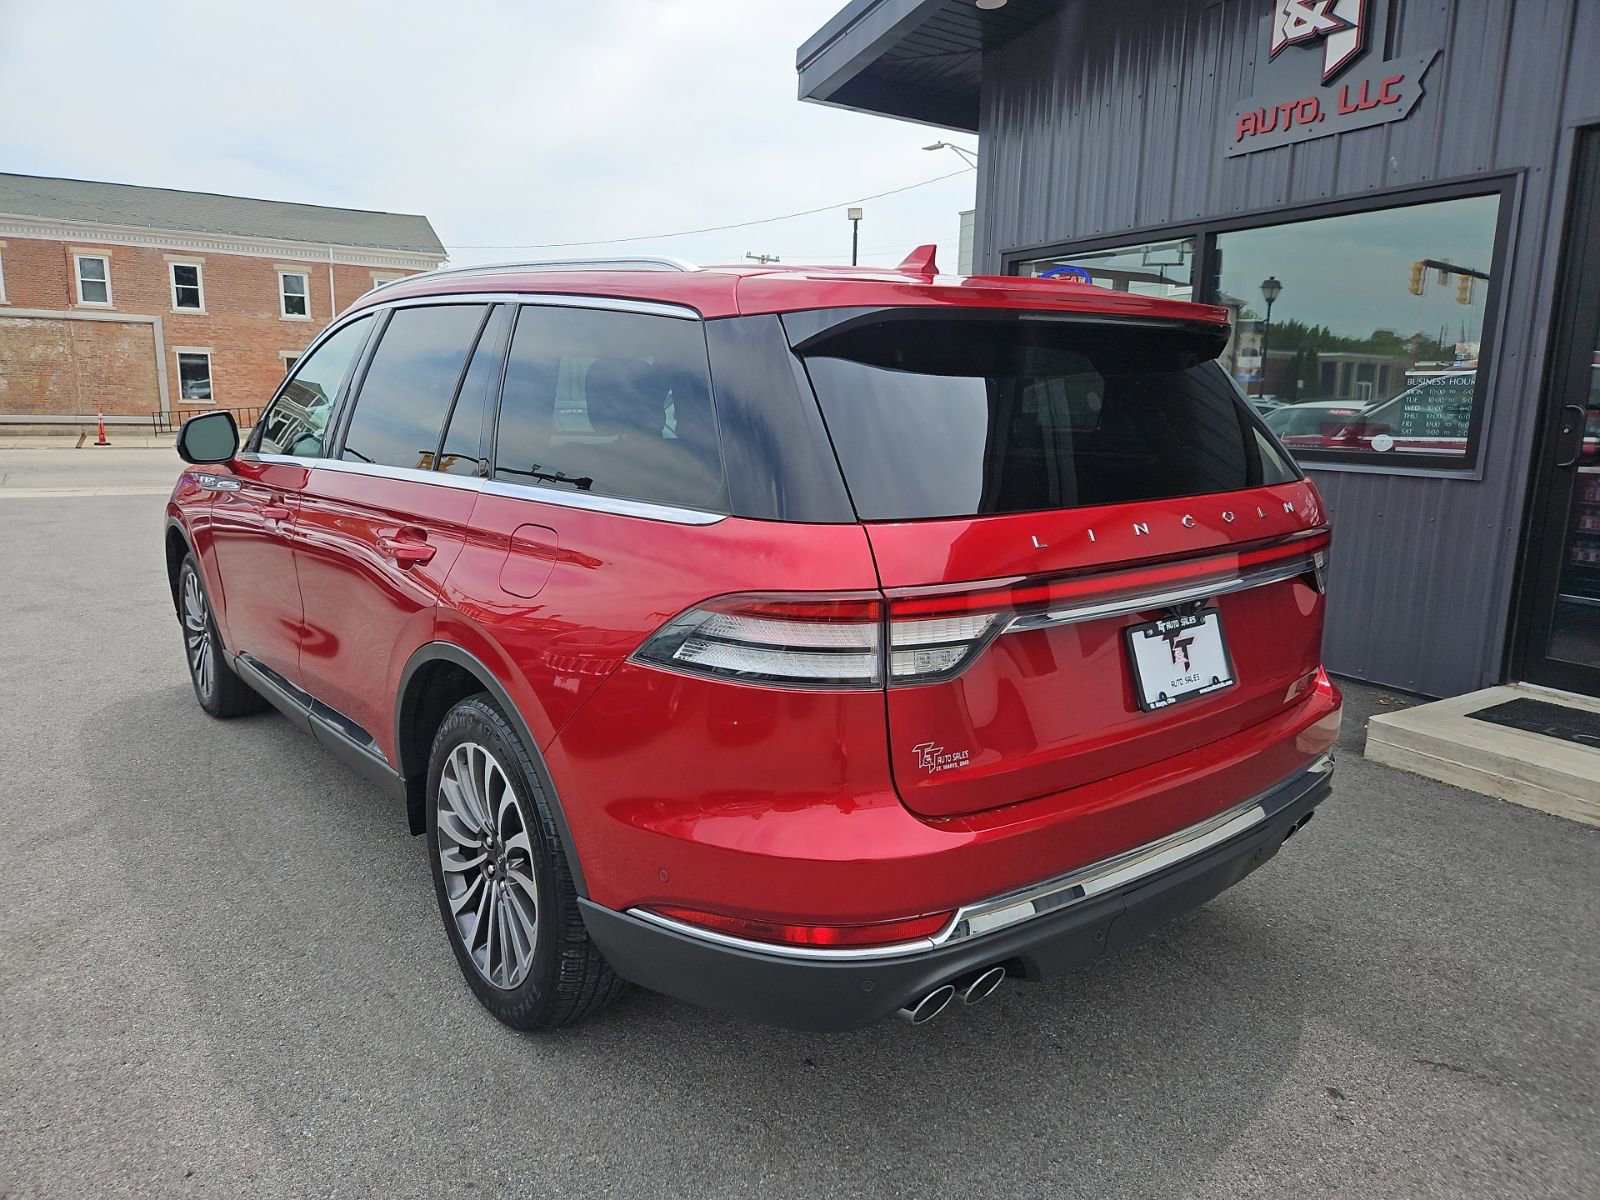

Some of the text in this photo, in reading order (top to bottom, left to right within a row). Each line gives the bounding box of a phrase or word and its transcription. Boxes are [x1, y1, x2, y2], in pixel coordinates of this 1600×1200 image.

[1236, 75, 1405, 142] AUTO, LLC
[1407, 378, 1446, 386] BUSINESS
[1031, 500, 1294, 549] LINCOLN
[1166, 619, 1180, 631] AUTO
[1180, 615, 1197, 627] SALES
[1170, 673, 1200, 688] AUTO SALES
[912, 741, 969, 774] T&T AUTO SALES
